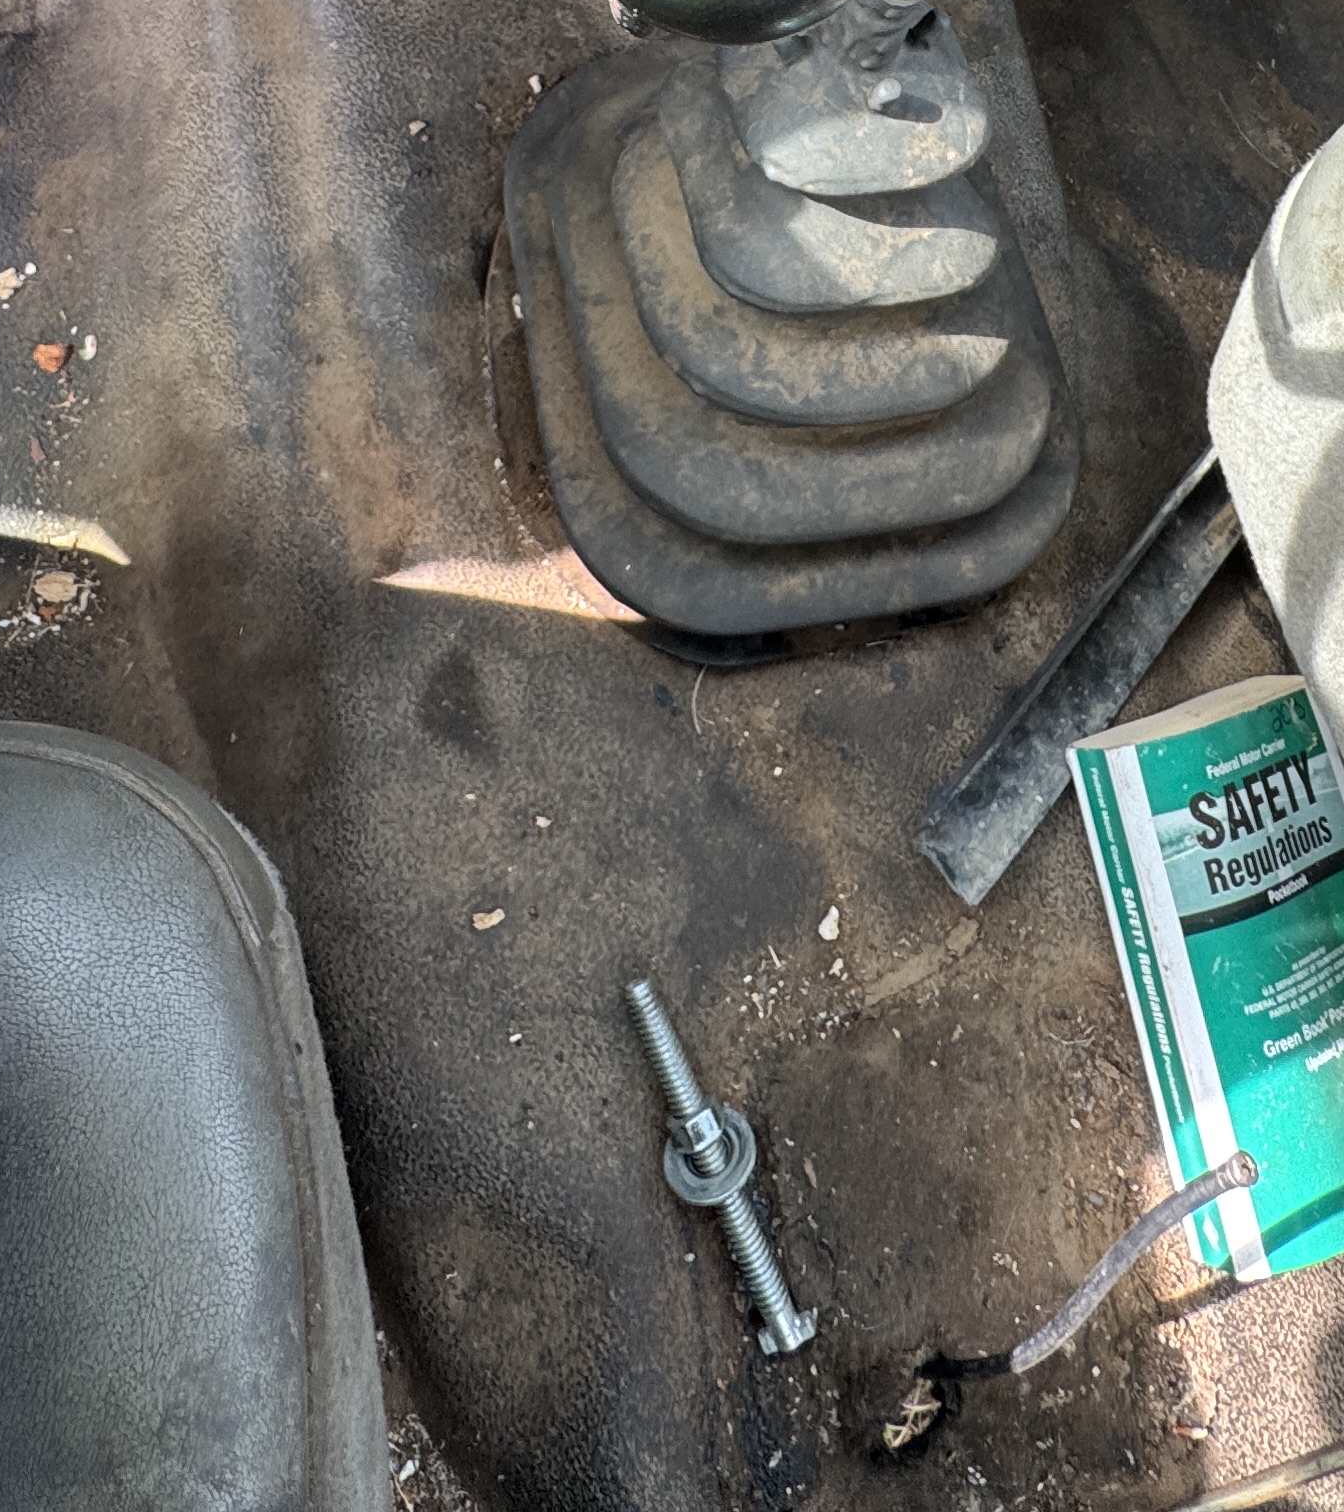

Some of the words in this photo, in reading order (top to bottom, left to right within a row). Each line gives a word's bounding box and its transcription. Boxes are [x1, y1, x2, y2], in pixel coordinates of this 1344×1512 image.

[1205, 755, 1241, 780] Federal
[1239, 746, 1262, 770] Motor
[1260, 738, 1287, 757] Carrier
[1189, 751, 1317, 849] SAFETY
[1203, 816, 1333, 896] Regulations
[1121, 886, 1148, 950] SAFETY
[1137, 952, 1173, 1057] Regulations
[1262, 1032, 1302, 1057] Green
